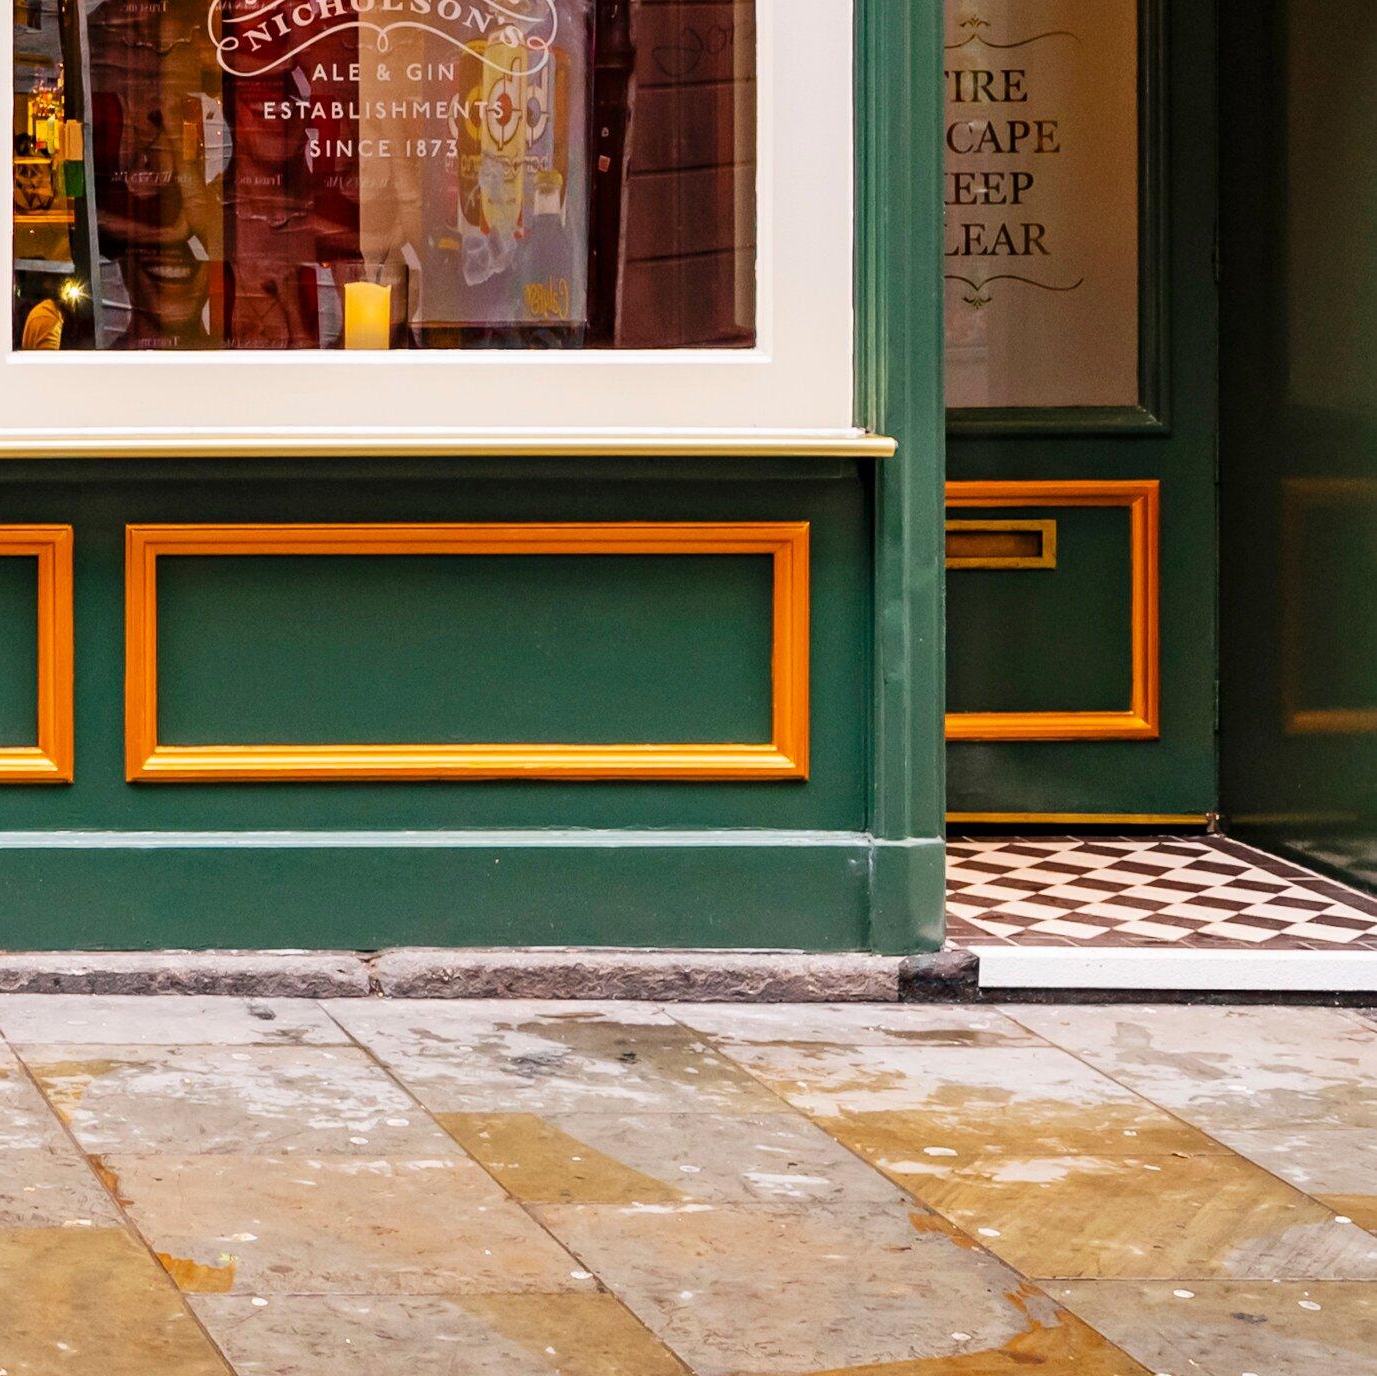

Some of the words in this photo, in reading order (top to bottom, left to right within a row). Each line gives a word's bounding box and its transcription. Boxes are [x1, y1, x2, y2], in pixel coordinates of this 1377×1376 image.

[312, 64, 360, 81] ALE
[376, 64, 390, 81] &
[406, 64, 455, 81] GIN
[944, 69, 1028, 102] IRE
[263, 102, 504, 120] ESTABLISHMENTS
[309, 139, 390, 157] SINCE
[406, 139, 458, 157] 1873
[946, 120, 1061, 154] CAPE
[944, 172, 1034, 205] EEP
